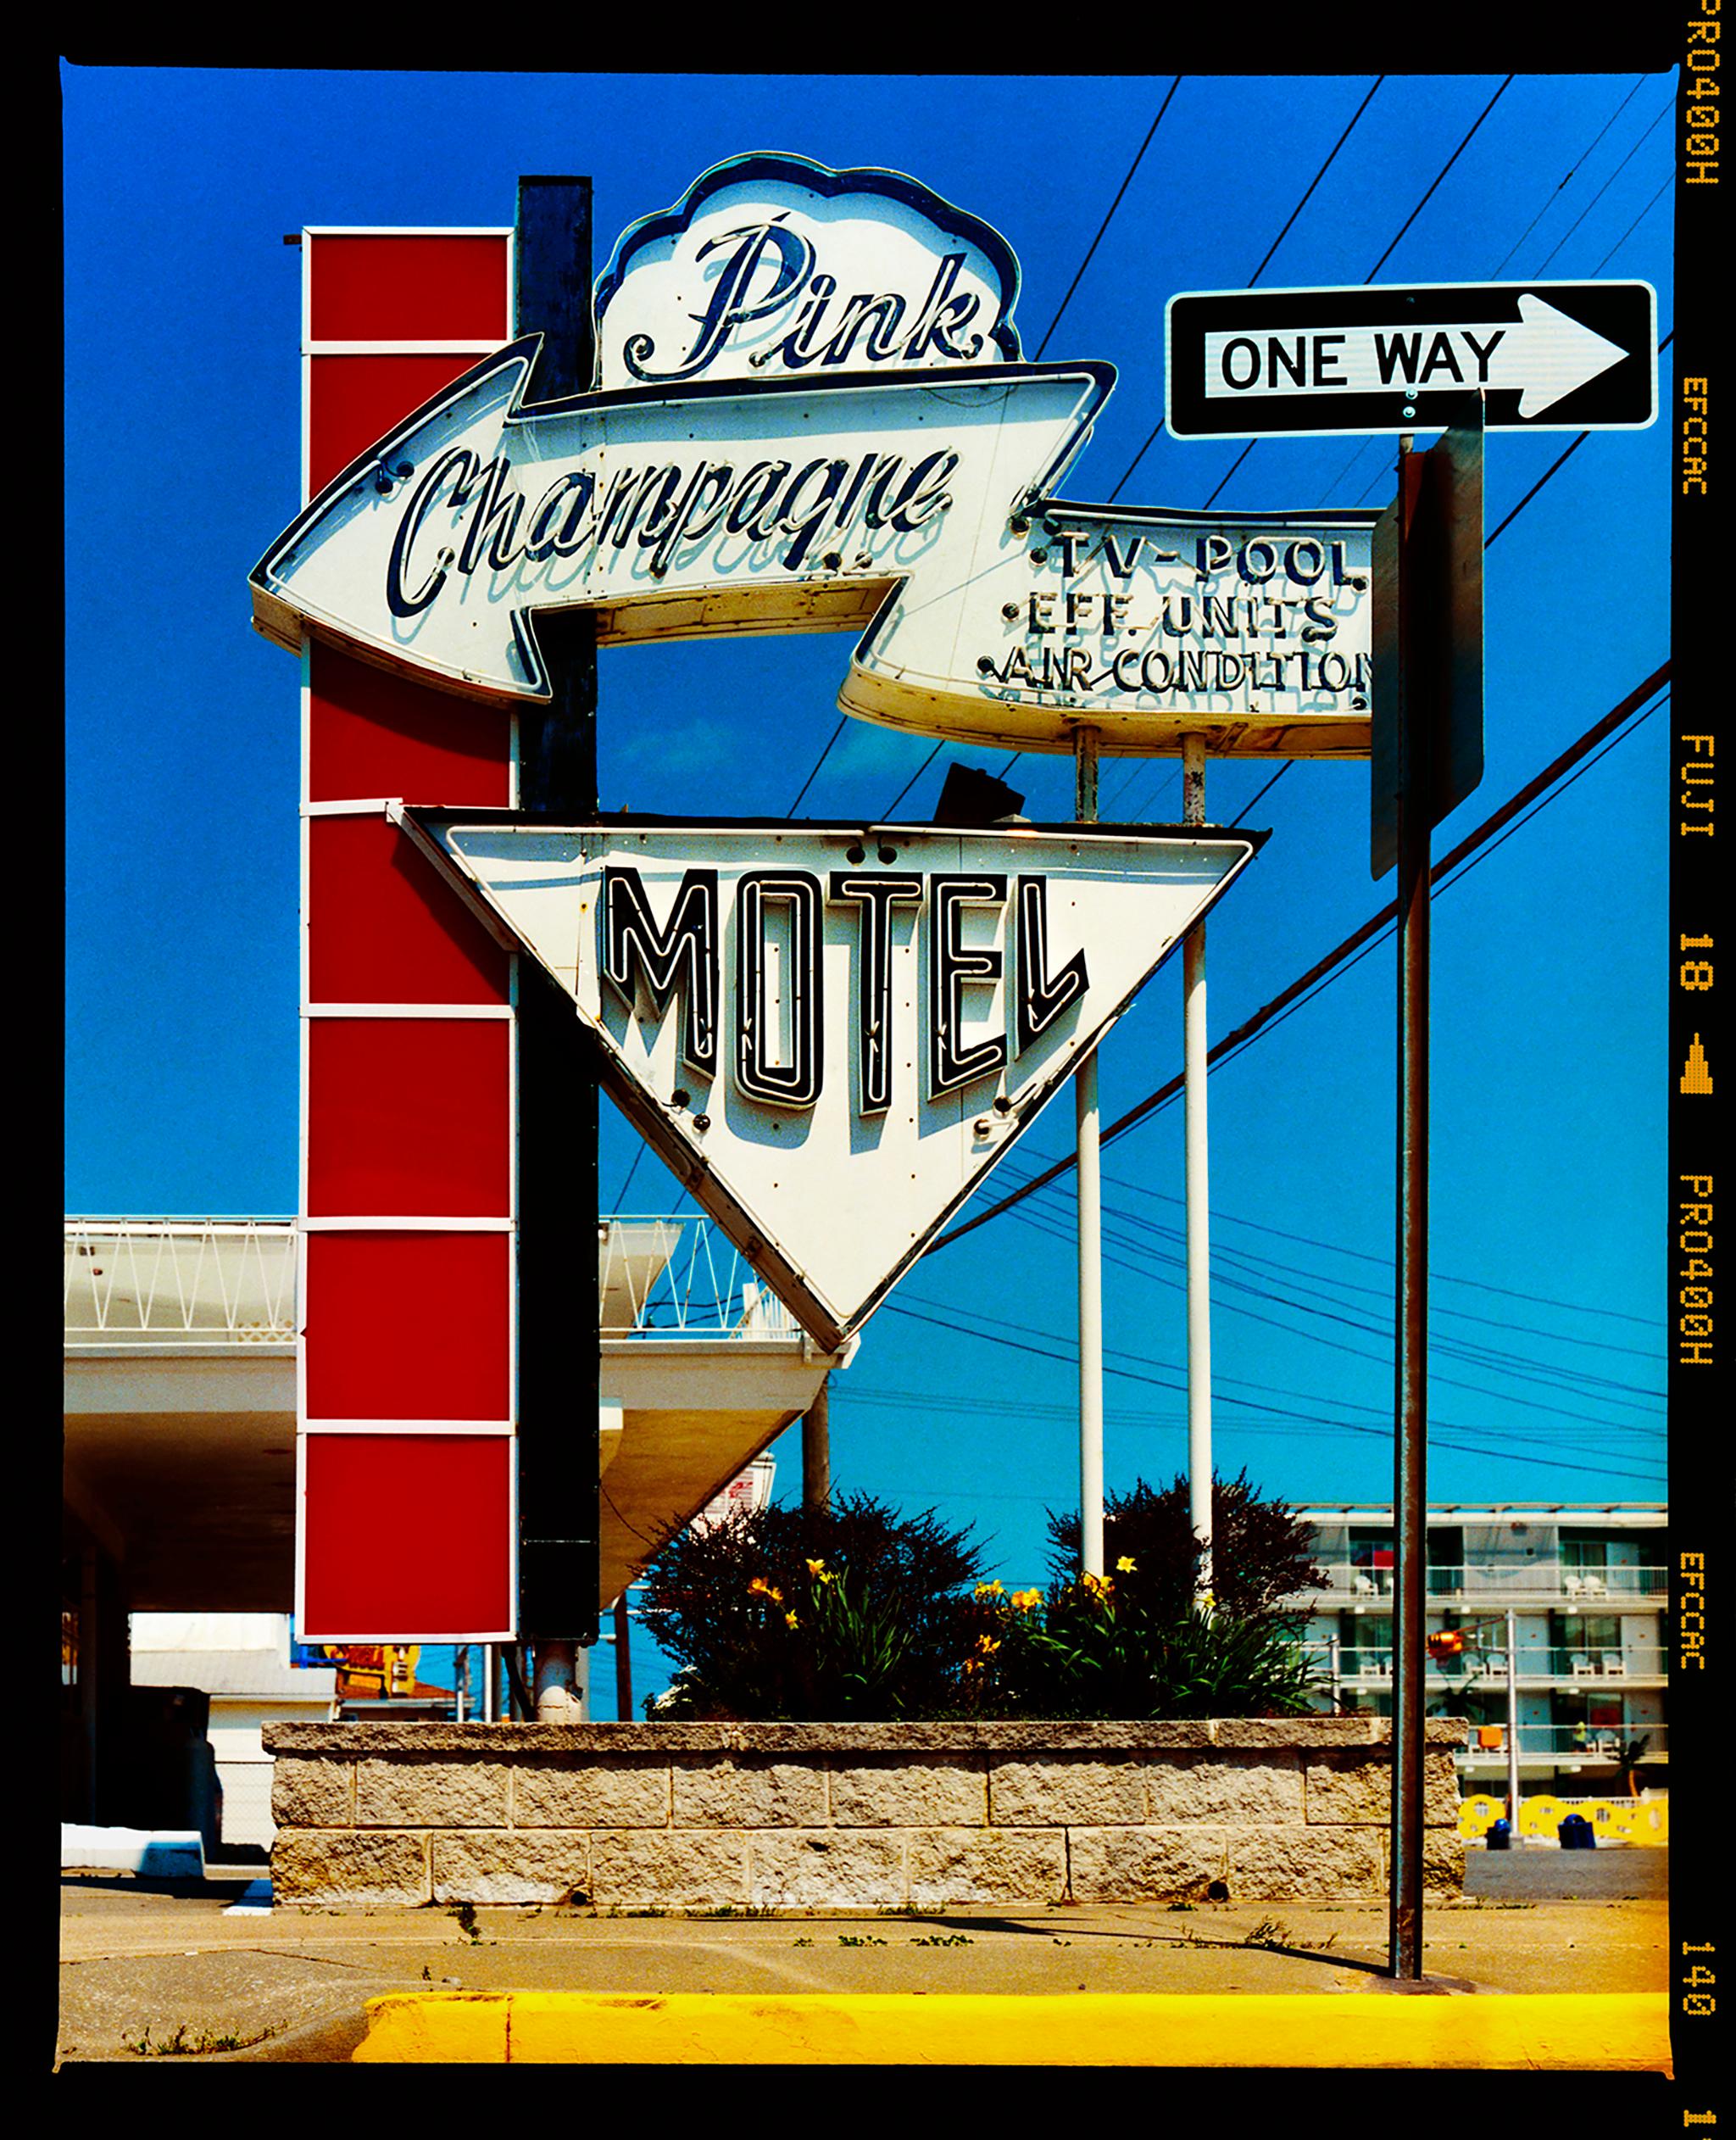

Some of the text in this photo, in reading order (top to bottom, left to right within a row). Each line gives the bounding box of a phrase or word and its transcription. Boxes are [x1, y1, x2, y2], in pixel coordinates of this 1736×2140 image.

[624, 212, 983, 382] Pink
[1221, 330, 1506, 391] ONE WAY
[1683, 376, 1708, 495] EFCCAC
[386, 445, 960, 618] Champagne
[1001, 646, 1093, 691] AIR
[1162, 595, 1339, 644] UNITS
[1680, 733, 1715, 837] FUJI
[601, 865, 1090, 1117] MOTEL
[1680, 932, 1714, 991] 18
[1679, 1174, 1713, 1365] PRO400H
[1680, 1551, 1705, 1670] EFCCAC
[1682, 1940, 1717, 2016] 140
